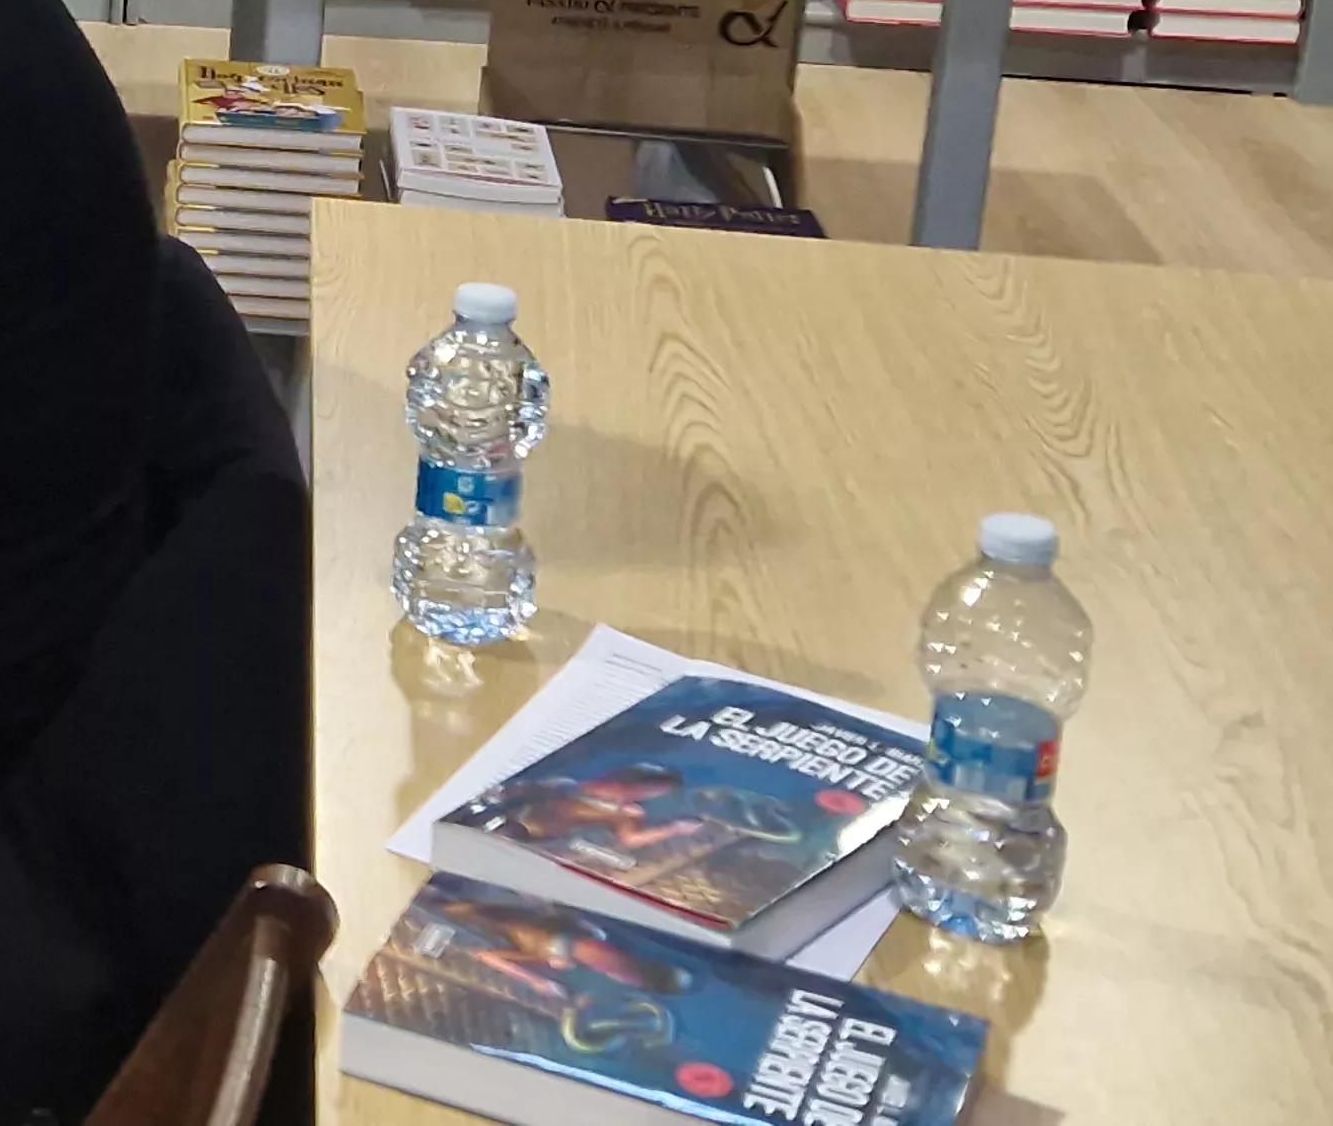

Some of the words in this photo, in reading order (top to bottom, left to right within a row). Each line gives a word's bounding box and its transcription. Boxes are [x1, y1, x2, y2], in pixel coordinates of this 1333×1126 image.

[659, 714, 713, 741] LA
[708, 728, 895, 802] SERPIENTE
[710, 706, 757, 732] EL
[755, 721, 869, 766] JUEGO
[865, 754, 923, 789] DE
[786, 988, 846, 1021] LA
[837, 1017, 898, 1047] EL
[802, 1097, 865, 1126] D
